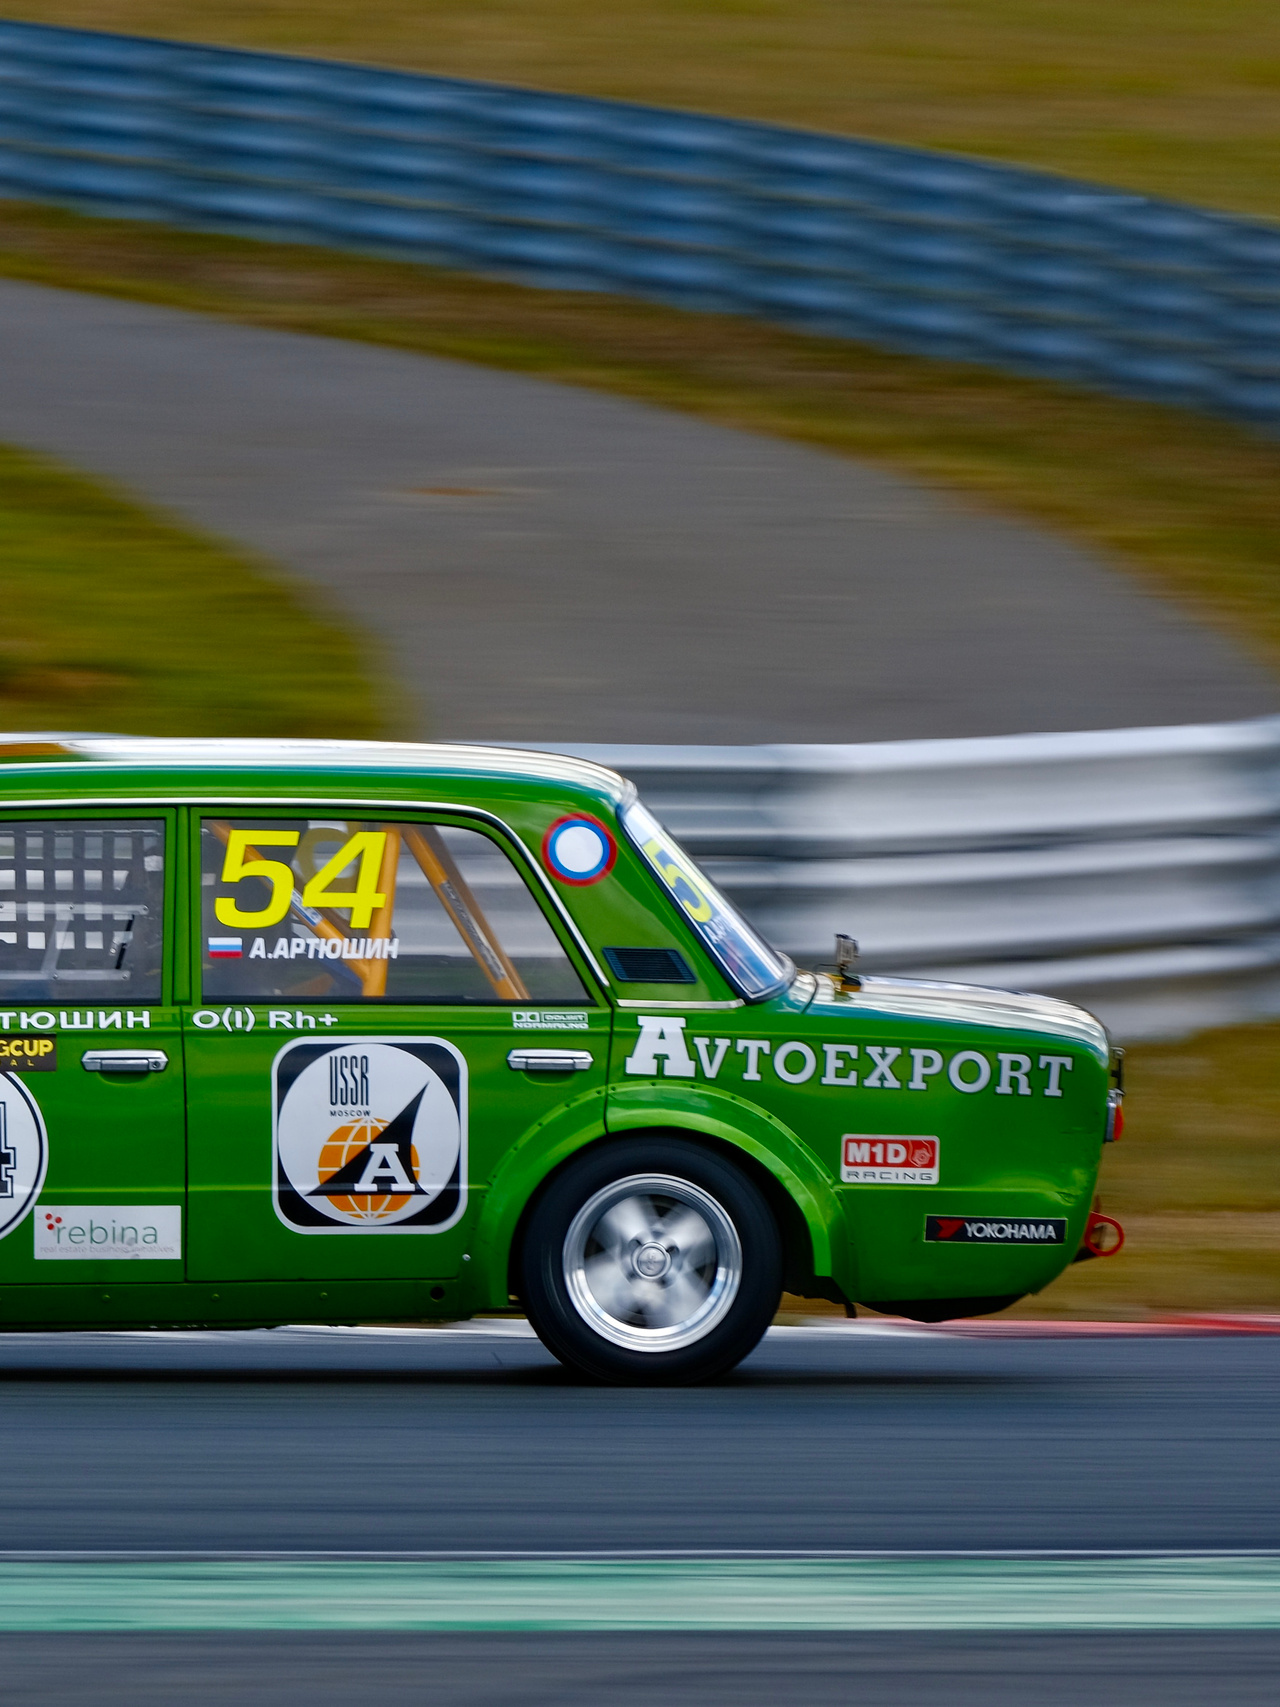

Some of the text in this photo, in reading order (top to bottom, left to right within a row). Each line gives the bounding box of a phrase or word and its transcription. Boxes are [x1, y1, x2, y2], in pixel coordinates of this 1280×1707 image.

[213, 828, 387, 929] 54
[249, 937, 400, 960] А.АРТЮШИН
[268, 1010, 339, 1029] Rh+
[625, 1015, 1074, 1098] AVTOEXPORT
[329, 1055, 370, 1106] USSR
[329, 1109, 372, 1117] MOSCOW
[845, 1141, 907, 1165] M1D
[353, 1143, 416, 1192] A
[846, 1170, 933, 1181] RACING
[56, 1219, 158, 1244] rebina
[964, 1221, 1057, 1240] YOKOHAMA
